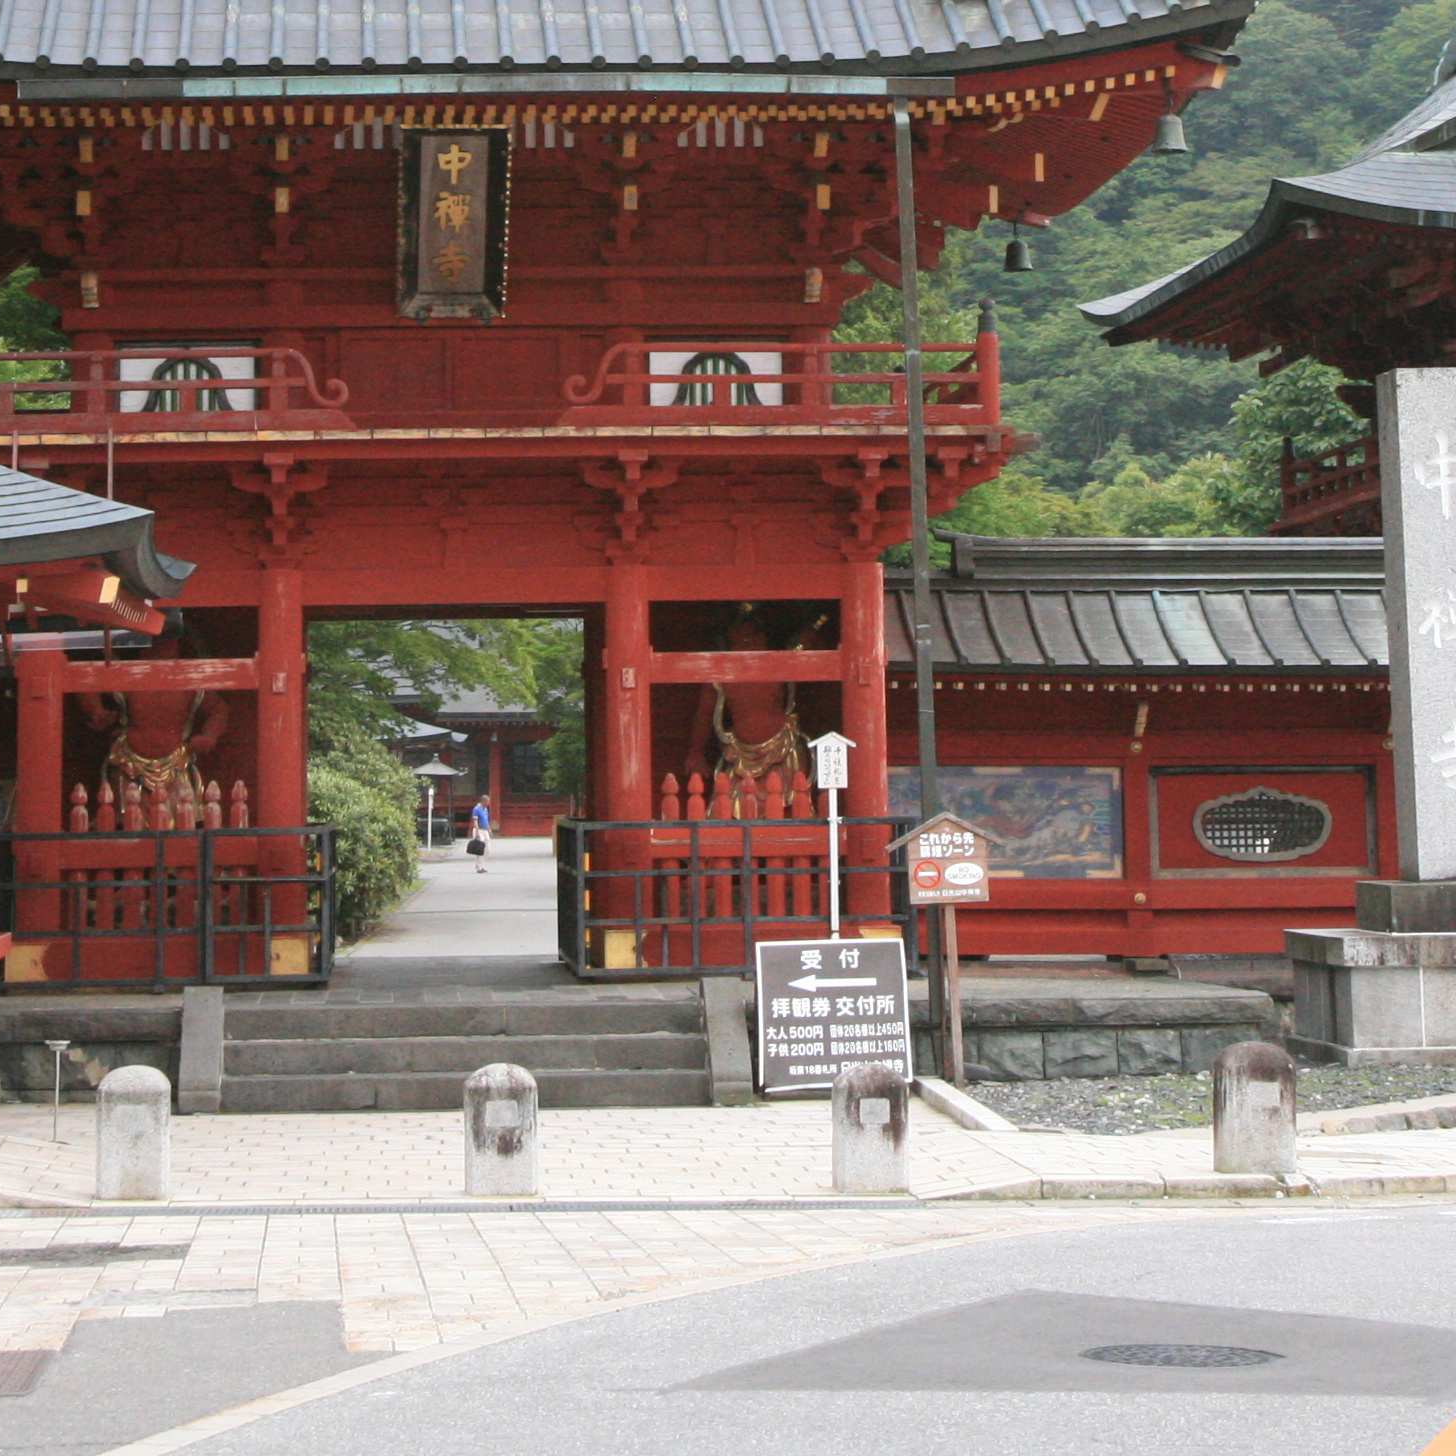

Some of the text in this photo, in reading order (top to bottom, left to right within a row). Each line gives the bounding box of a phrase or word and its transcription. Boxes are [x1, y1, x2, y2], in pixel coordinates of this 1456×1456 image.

[920, 832, 975, 845] これから先
[771, 995, 895, 1018] 拝観券 交付所
[766, 1025, 824, 1040] 大人500円
